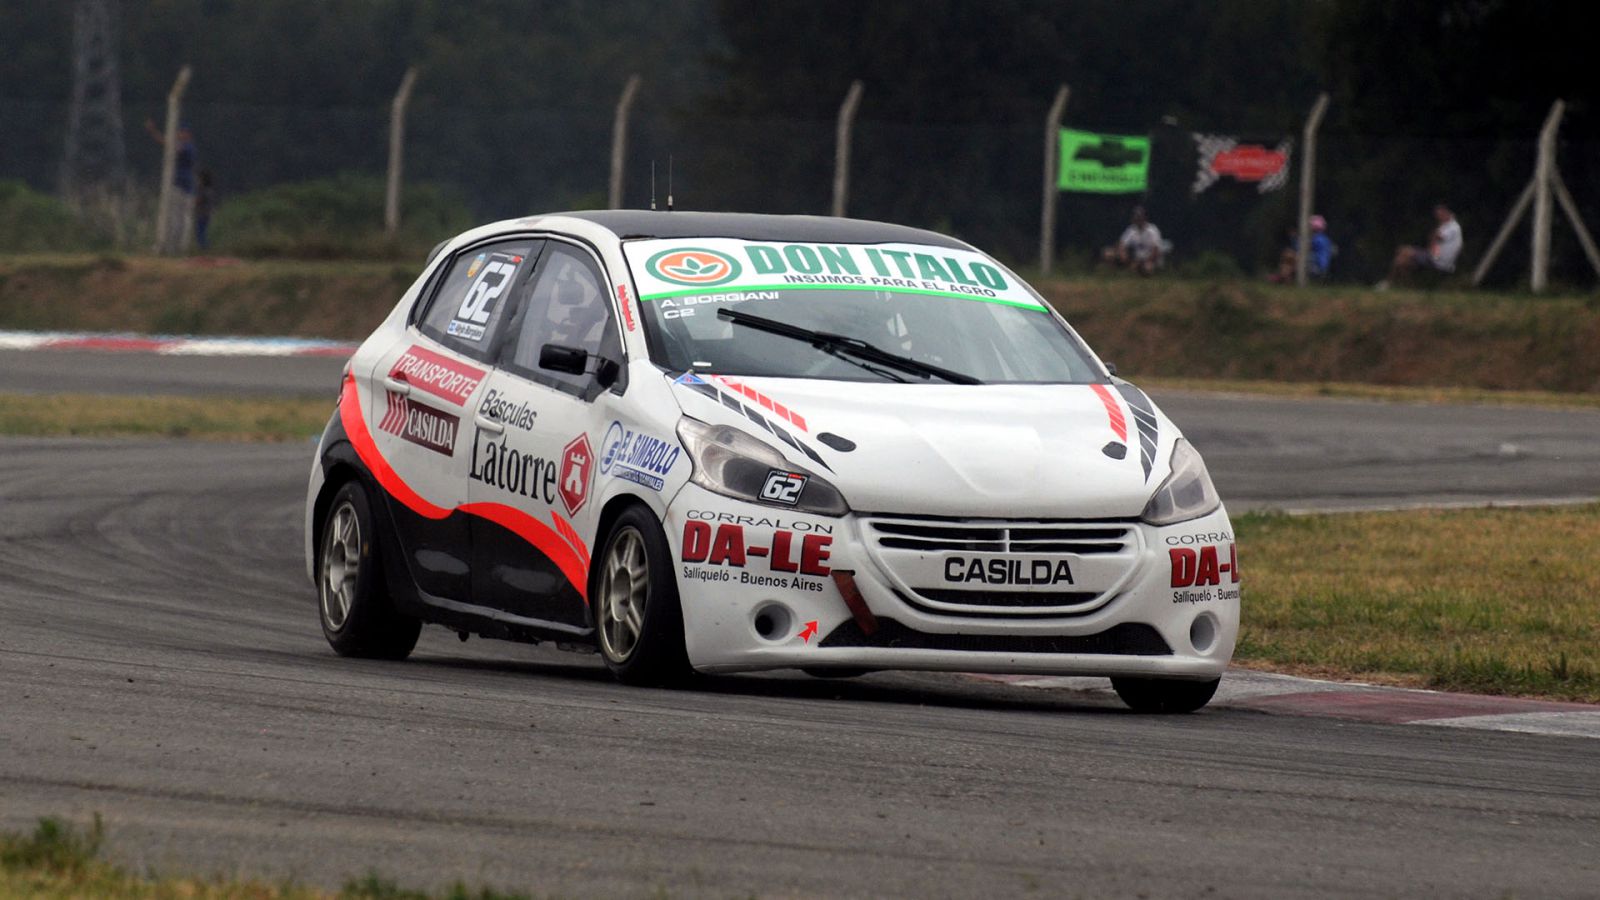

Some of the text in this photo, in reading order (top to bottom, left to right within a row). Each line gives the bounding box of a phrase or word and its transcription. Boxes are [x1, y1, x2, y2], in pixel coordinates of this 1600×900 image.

[743, 245, 1009, 291] DON ITALO
[458, 261, 516, 323] 62
[661, 291, 779, 308] A. BORGIANI
[784, 275, 996, 297] INSUMOS PARA EL AGRO
[663, 308, 695, 319] C2
[394, 353, 479, 397] TRANSPORTE
[479, 388, 537, 431] Básculas
[408, 408, 453, 450] CASILDA
[469, 426, 557, 505] Latorre
[616, 430, 680, 475] EL SIMBOLO
[763, 475, 802, 502] 62
[687, 509, 833, 534] CORRALON
[682, 520, 833, 577] DA-LE
[683, 566, 730, 583] Salliqueló
[740, 571, 788, 589] Buenos
[791, 577, 823, 592] Aires
[944, 557, 1075, 585] CASILDA
[1173, 589, 1211, 605] Salliqueló
